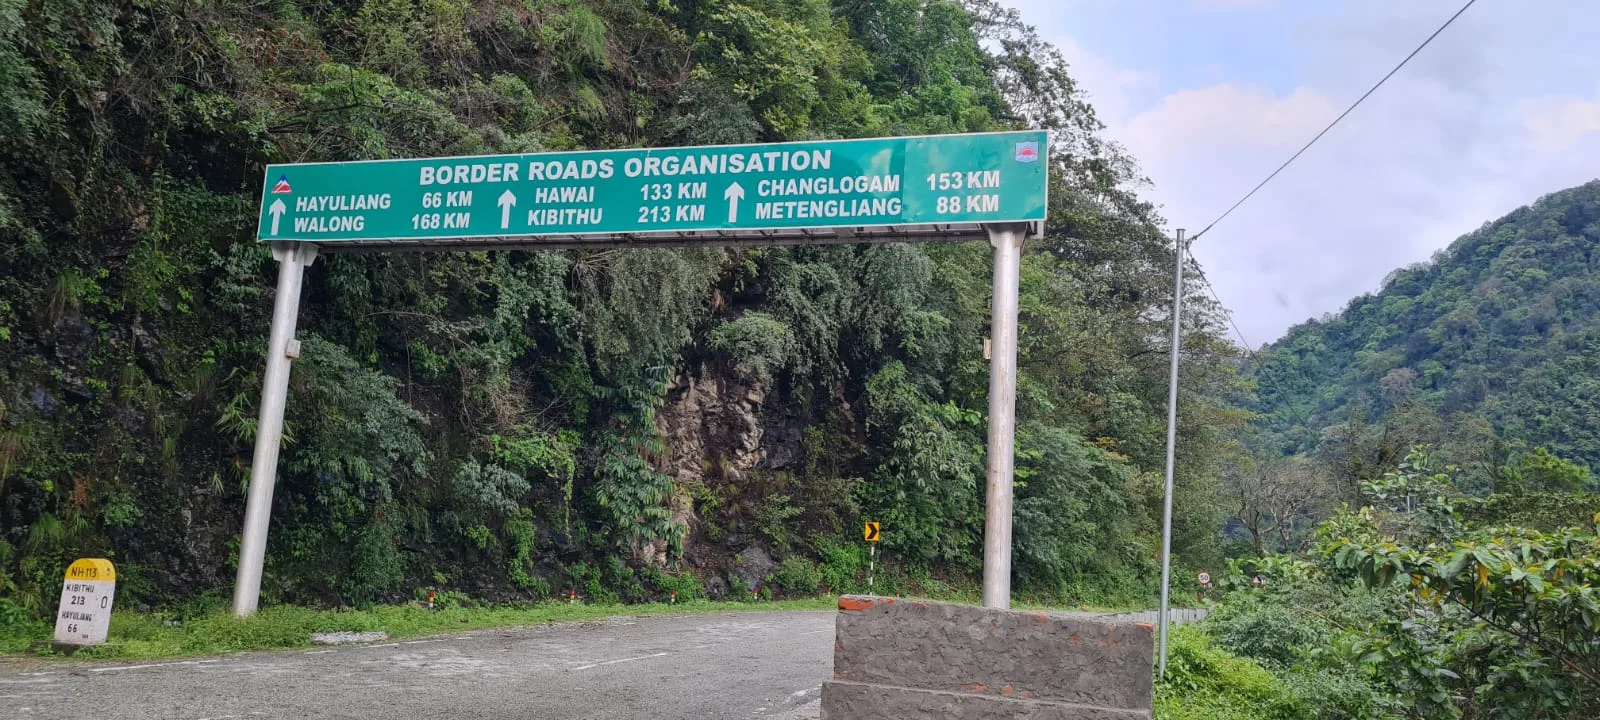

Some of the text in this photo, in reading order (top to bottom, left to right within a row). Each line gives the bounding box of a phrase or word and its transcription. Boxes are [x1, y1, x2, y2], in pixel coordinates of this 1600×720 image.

[419, 150, 832, 185] BORDER ROADS ORGANISATION
[535, 182, 707, 204] HAWAI 133 KM
[757, 170, 1000, 196] CHANGLOGAM 153 KM
[296, 190, 472, 212] HAYULIANG 66 KM
[755, 194, 999, 219] METENGLIANG 88 KM
[294, 212, 470, 233] WALONG 168 KM
[527, 204, 705, 226] KIBITHU 213 KM
[71, 595, 85, 605] 213
[67, 623, 78, 633] 66
